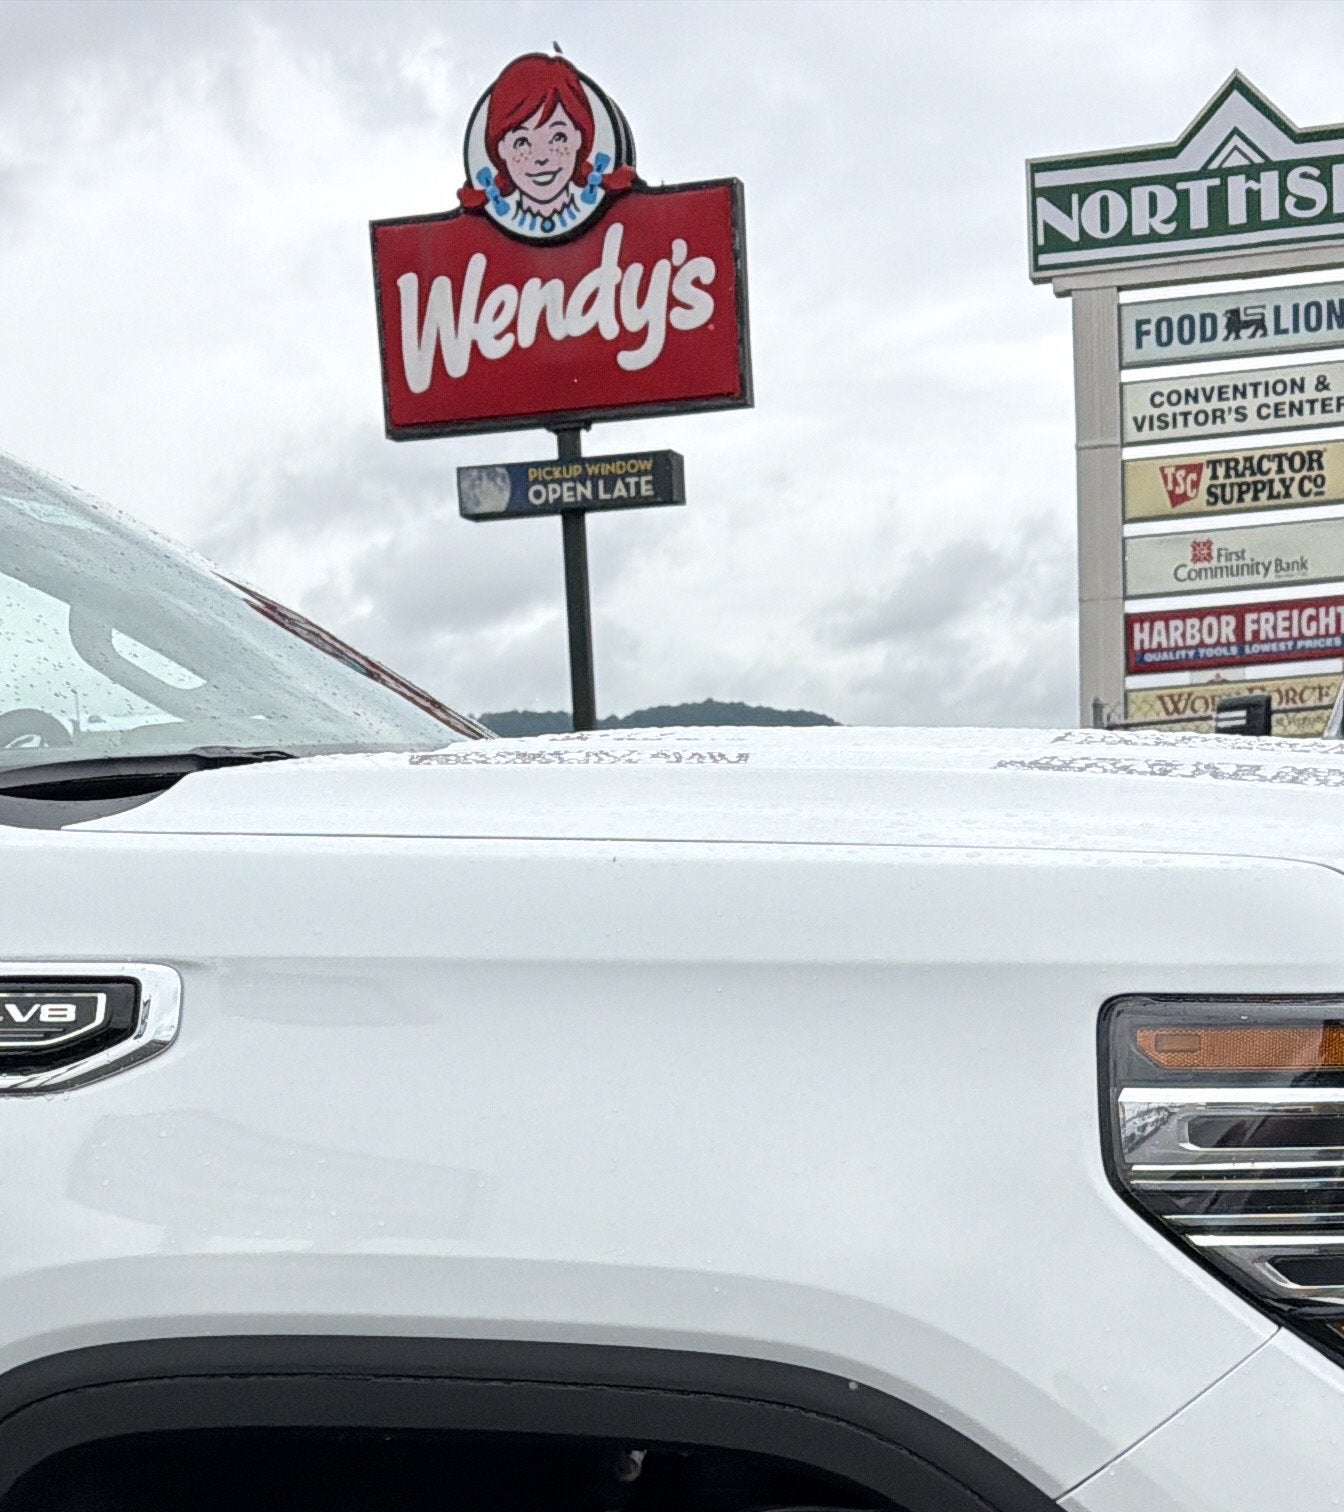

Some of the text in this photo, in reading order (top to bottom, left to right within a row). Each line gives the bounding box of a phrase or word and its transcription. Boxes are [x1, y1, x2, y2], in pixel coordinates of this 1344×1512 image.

[397, 223, 716, 393] Wendy's
[1135, 312, 1218, 350] FOOD
[1149, 374, 1331, 409] CONVENTION &
[1132, 405, 1248, 433] VISITOR'S
[528, 458, 654, 482] PICKUP WINDOW
[1164, 450, 1325, 498] TSC TRACTOR
[528, 475, 655, 506] OPEN LATE
[1206, 476, 1295, 507] SUPPLY
[1173, 556, 1309, 583] Community Bank
[1216, 547, 1247, 563] First
[1133, 614, 1236, 651] HARBOR
[1143, 636, 1342, 663] QUALITY TOOLS LOWEST PRICES
